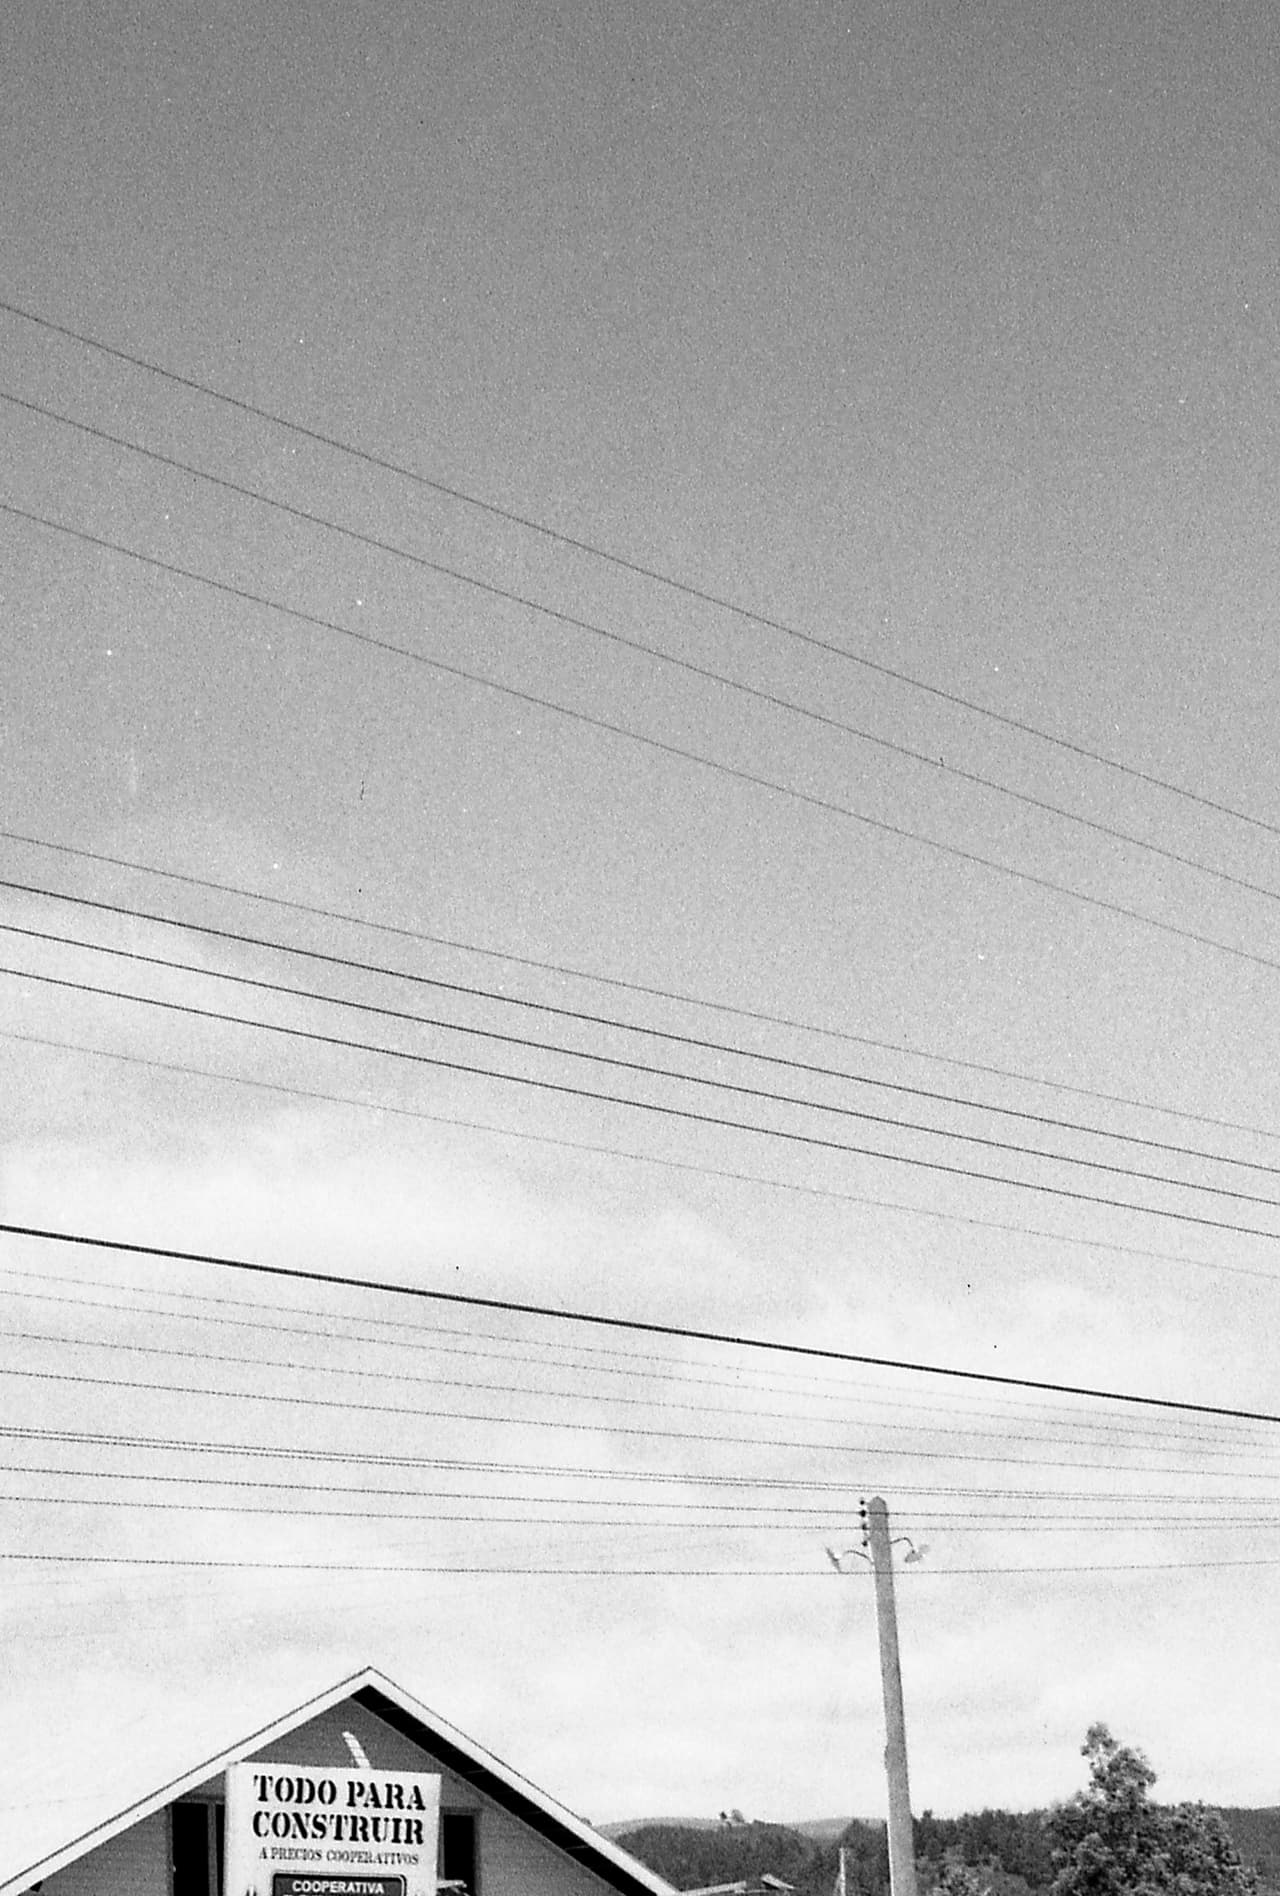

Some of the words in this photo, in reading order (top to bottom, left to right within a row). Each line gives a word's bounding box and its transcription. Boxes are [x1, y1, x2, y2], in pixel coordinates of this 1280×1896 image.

[254, 1775, 337, 1805] TODO
[346, 1781, 426, 1811] PARA
[253, 1811, 424, 1845] CONSTRUIR
[259, 1848, 268, 1860] A
[271, 1848, 322, 1861] PRECIOS
[326, 1850, 419, 1865] COOPERATIVOS
[292, 1881, 385, 1894] COOPERATIVA
